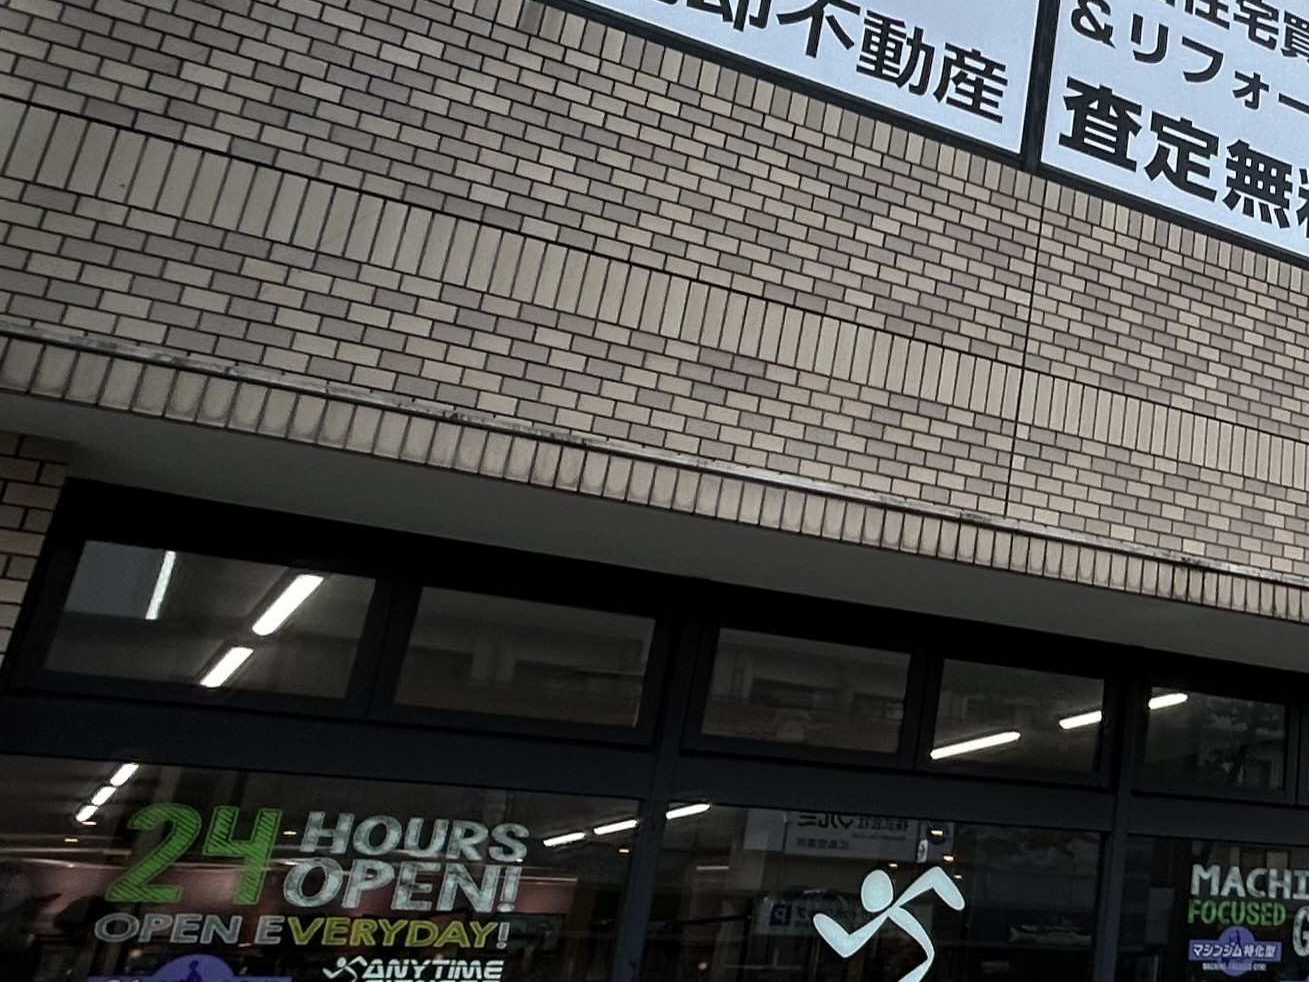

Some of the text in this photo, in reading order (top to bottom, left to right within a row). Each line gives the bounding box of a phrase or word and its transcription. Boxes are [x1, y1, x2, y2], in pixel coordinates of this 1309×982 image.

[105, 802, 284, 905] 24
[301, 809, 530, 863] HOURS
[282, 854, 522, 913] OPEN!
[93, 912, 511, 950] OPEN EVERYDAY!
[1187, 898, 1287, 927] FOCUSED
[361, 958, 504, 979] ANYTIME
